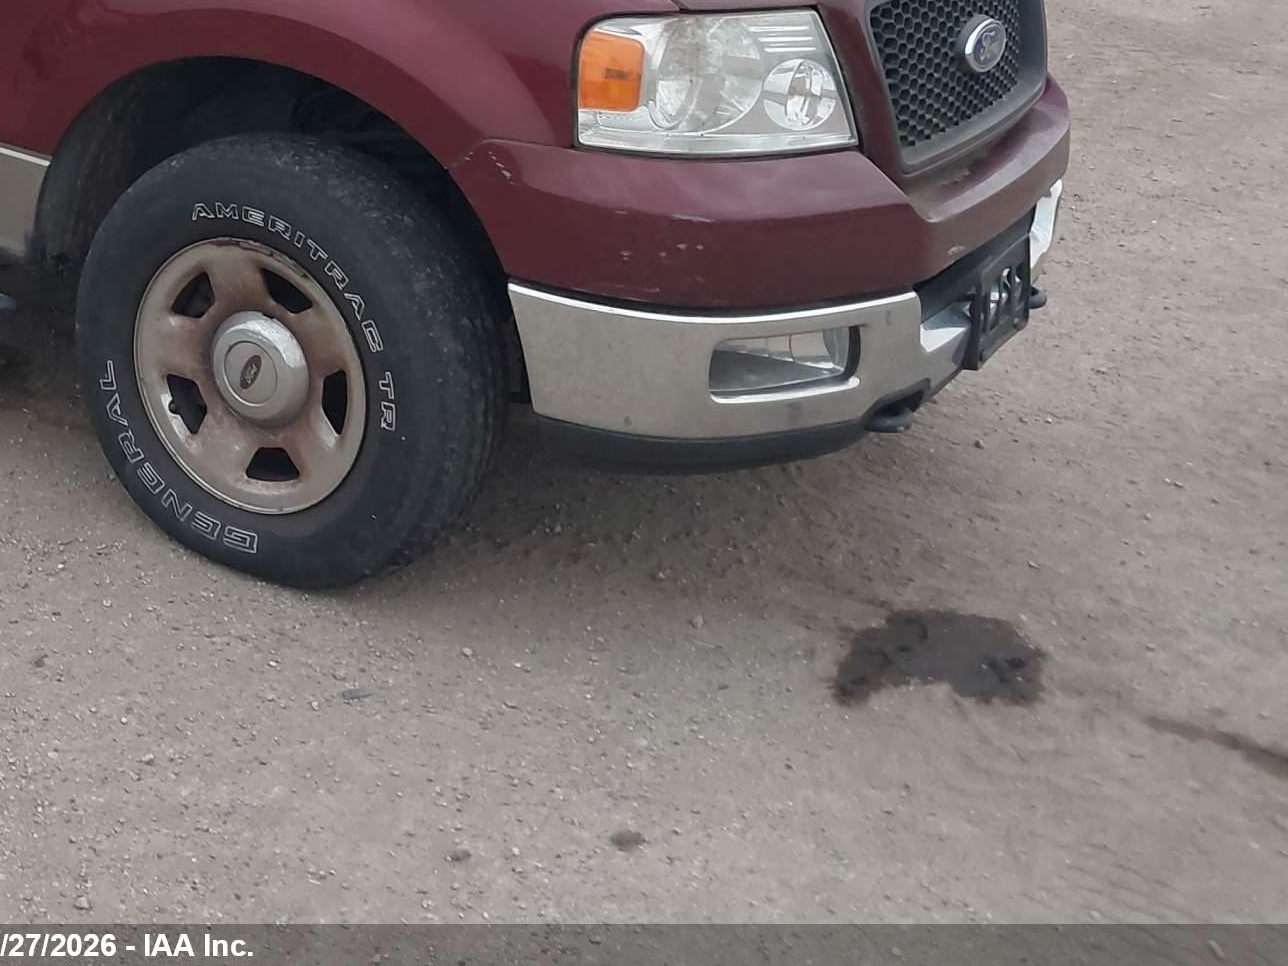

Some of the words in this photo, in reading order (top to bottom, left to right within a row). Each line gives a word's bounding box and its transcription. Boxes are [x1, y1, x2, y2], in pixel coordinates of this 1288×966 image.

[192, 202, 383, 353] AMERITRAC
[378, 371, 396, 432] TR
[100, 360, 258, 554] GENERAL
